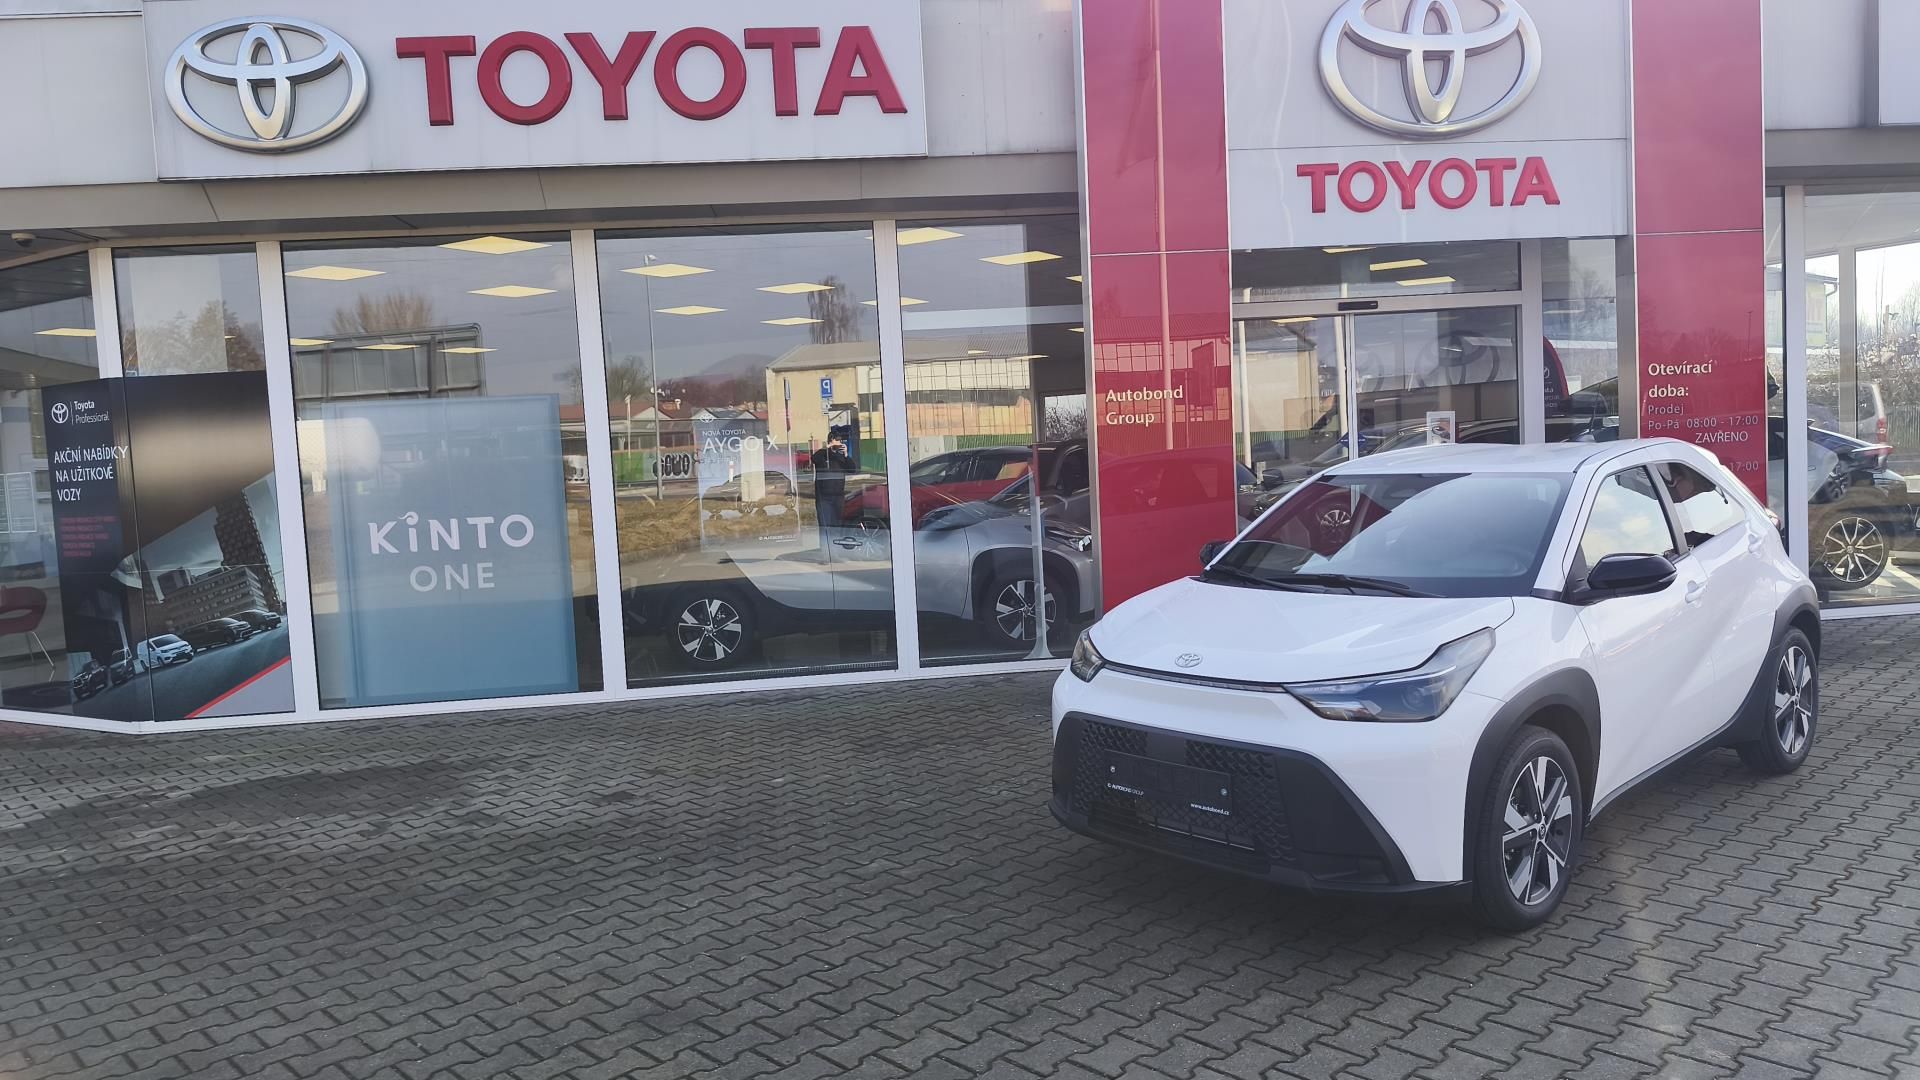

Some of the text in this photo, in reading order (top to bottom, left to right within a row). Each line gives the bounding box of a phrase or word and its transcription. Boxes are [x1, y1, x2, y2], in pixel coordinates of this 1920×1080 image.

[396, 26, 908, 126] TOYOTA
[1297, 157, 1561, 213] TOYOTA
[1648, 360, 1713, 375] Otevírací
[1106, 385, 1183, 402] Autobond
[1648, 384, 1690, 398] doba:
[74, 401, 95, 411] Toyota
[1648, 403, 1684, 415] Prodej
[1106, 412, 1155, 427] Group
[1648, 420, 1680, 430] Po-Pá
[1686, 418, 1717, 429] 08:00
[1729, 416, 1758, 426] 17:00
[703, 434, 779, 454] AYGO X
[1695, 430, 1748, 443] ZAVŘENO
[54, 444, 128, 464] AKČNÍ NABÍDKY
[55, 463, 114, 483] NA UŽITKOVÉ
[1730, 461, 1759, 471] 17:00
[57, 488, 81, 502] VOZY
[410, 562, 495, 592] ONE
